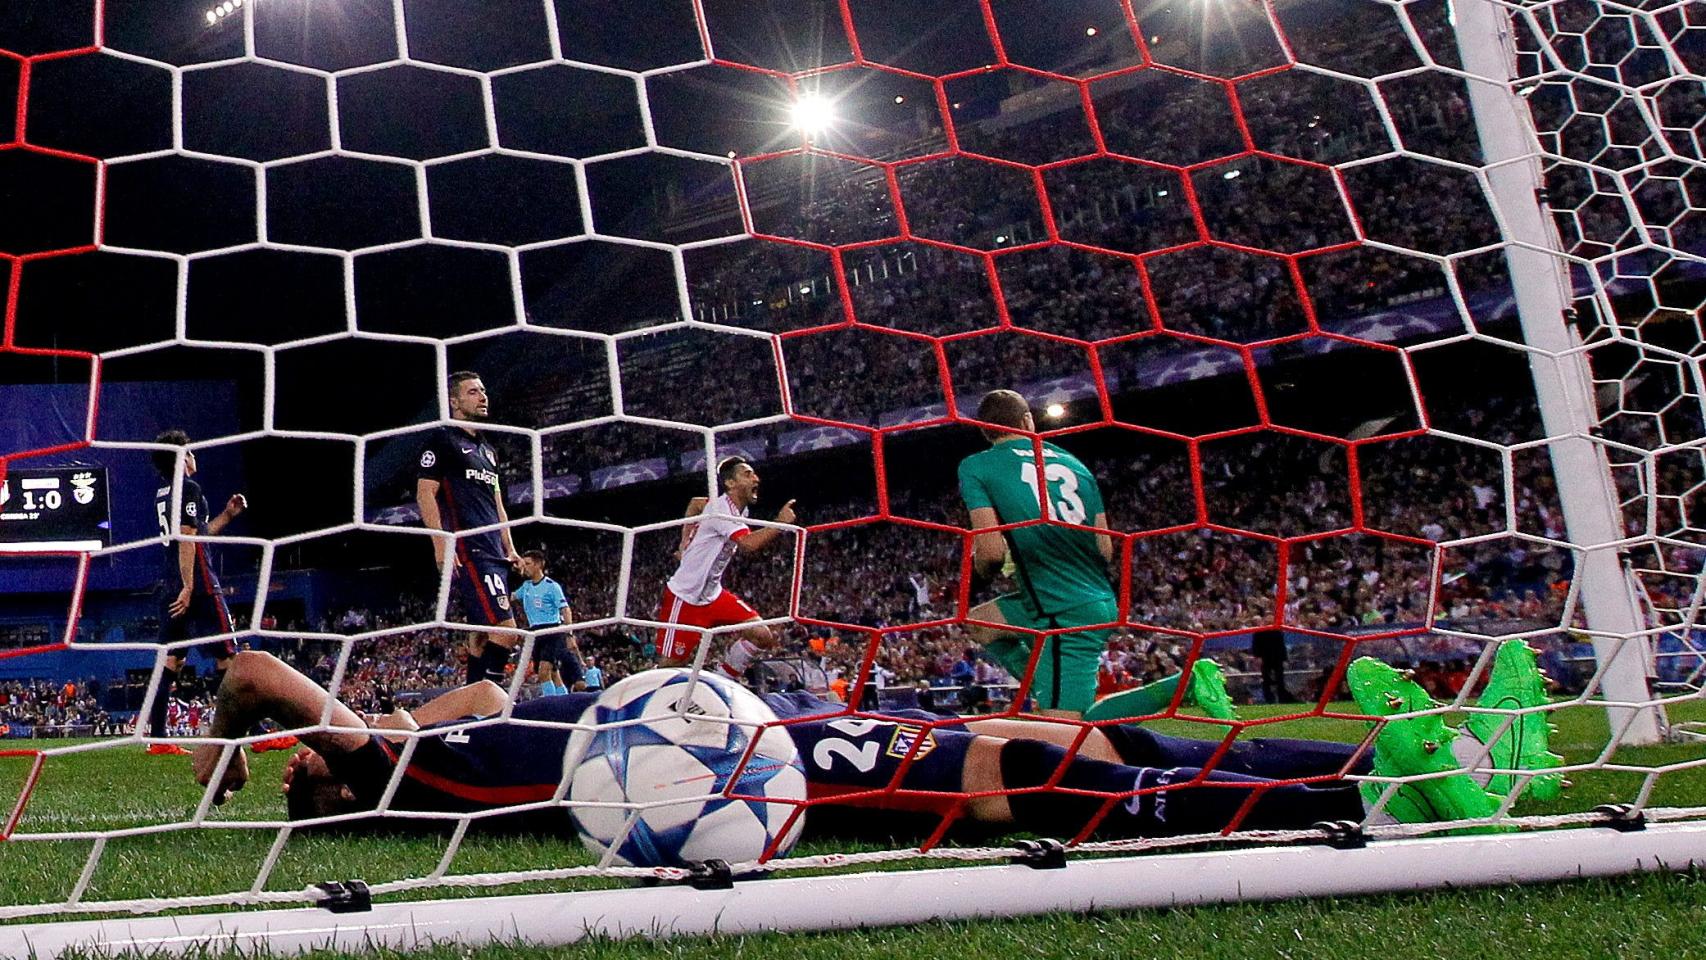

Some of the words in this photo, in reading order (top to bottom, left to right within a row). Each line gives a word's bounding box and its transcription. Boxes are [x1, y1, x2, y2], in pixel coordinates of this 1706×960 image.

[23, 490, 61, 510] 1:0
[1021, 462, 1086, 525] 13
[157, 501, 170, 547] 5
[484, 573, 506, 596] 14
[813, 718, 898, 773] 24
